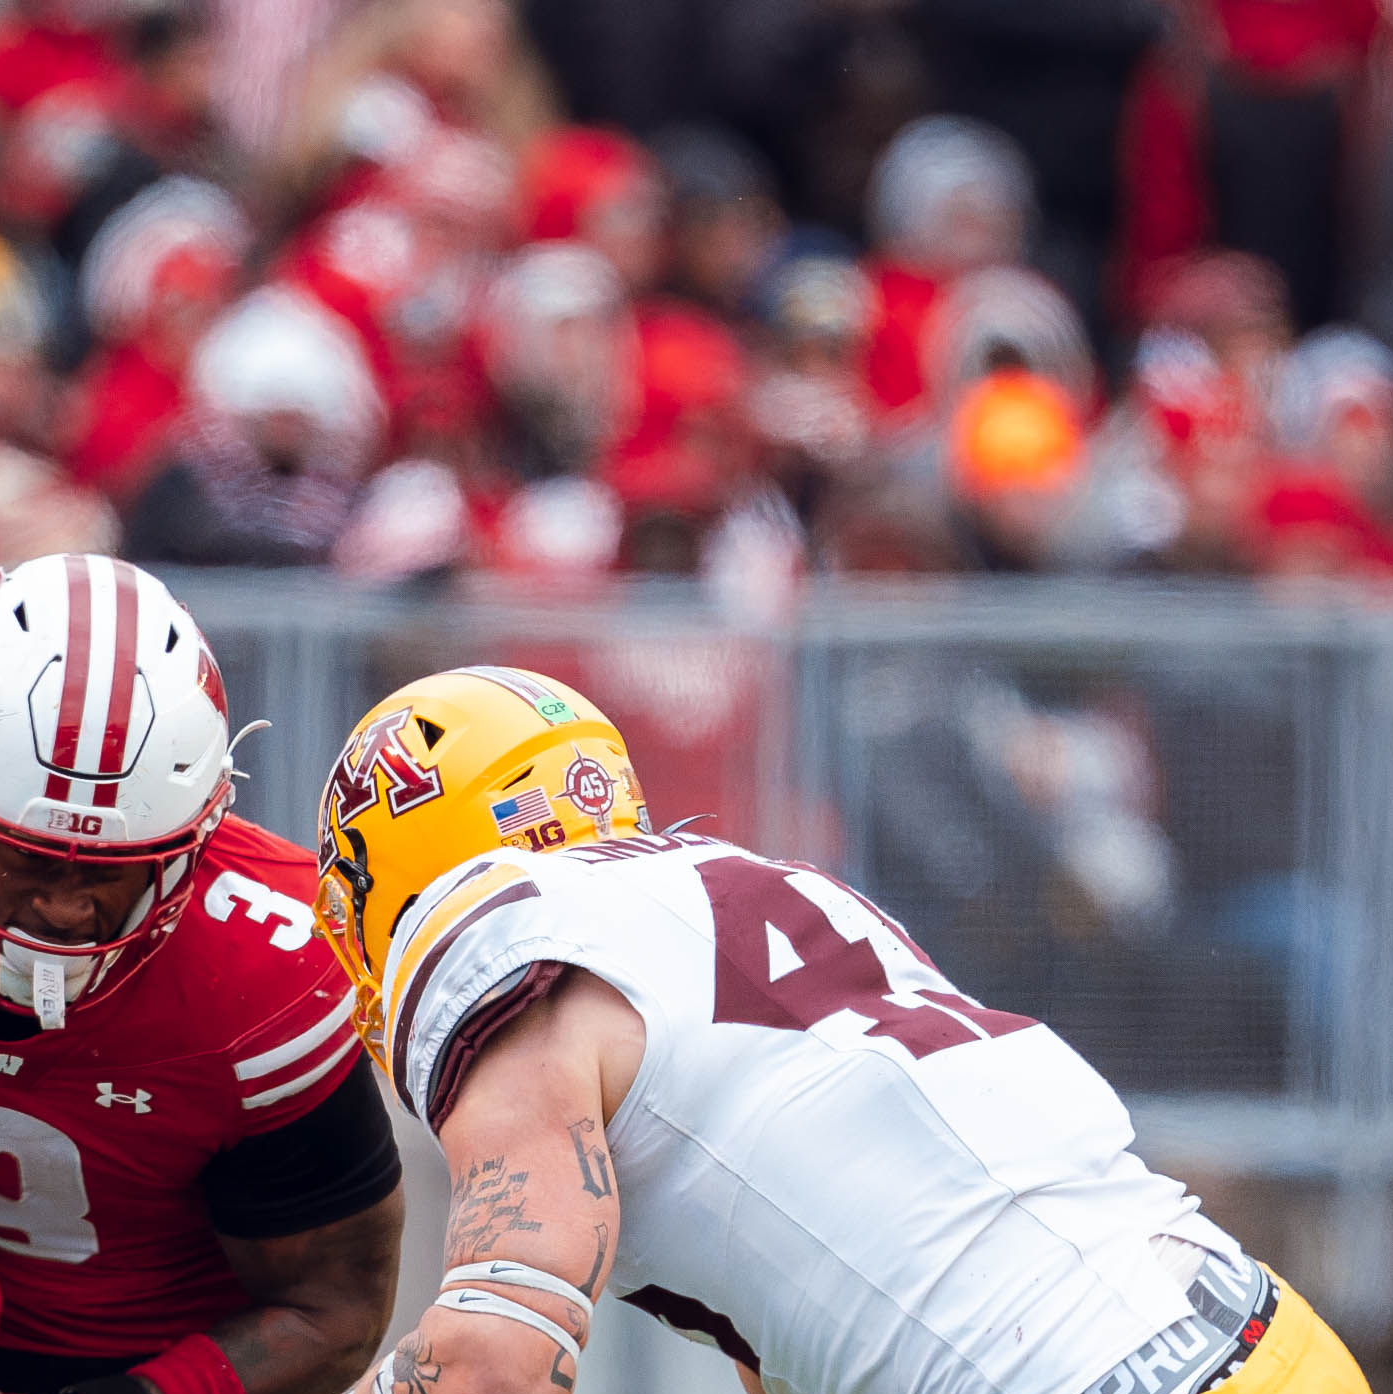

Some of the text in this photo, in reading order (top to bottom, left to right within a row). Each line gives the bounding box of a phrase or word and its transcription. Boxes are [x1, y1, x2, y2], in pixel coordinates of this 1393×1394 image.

[541, 701, 567, 717] C2P
[579, 772, 606, 800] 45
[205, 874, 317, 951] 3
